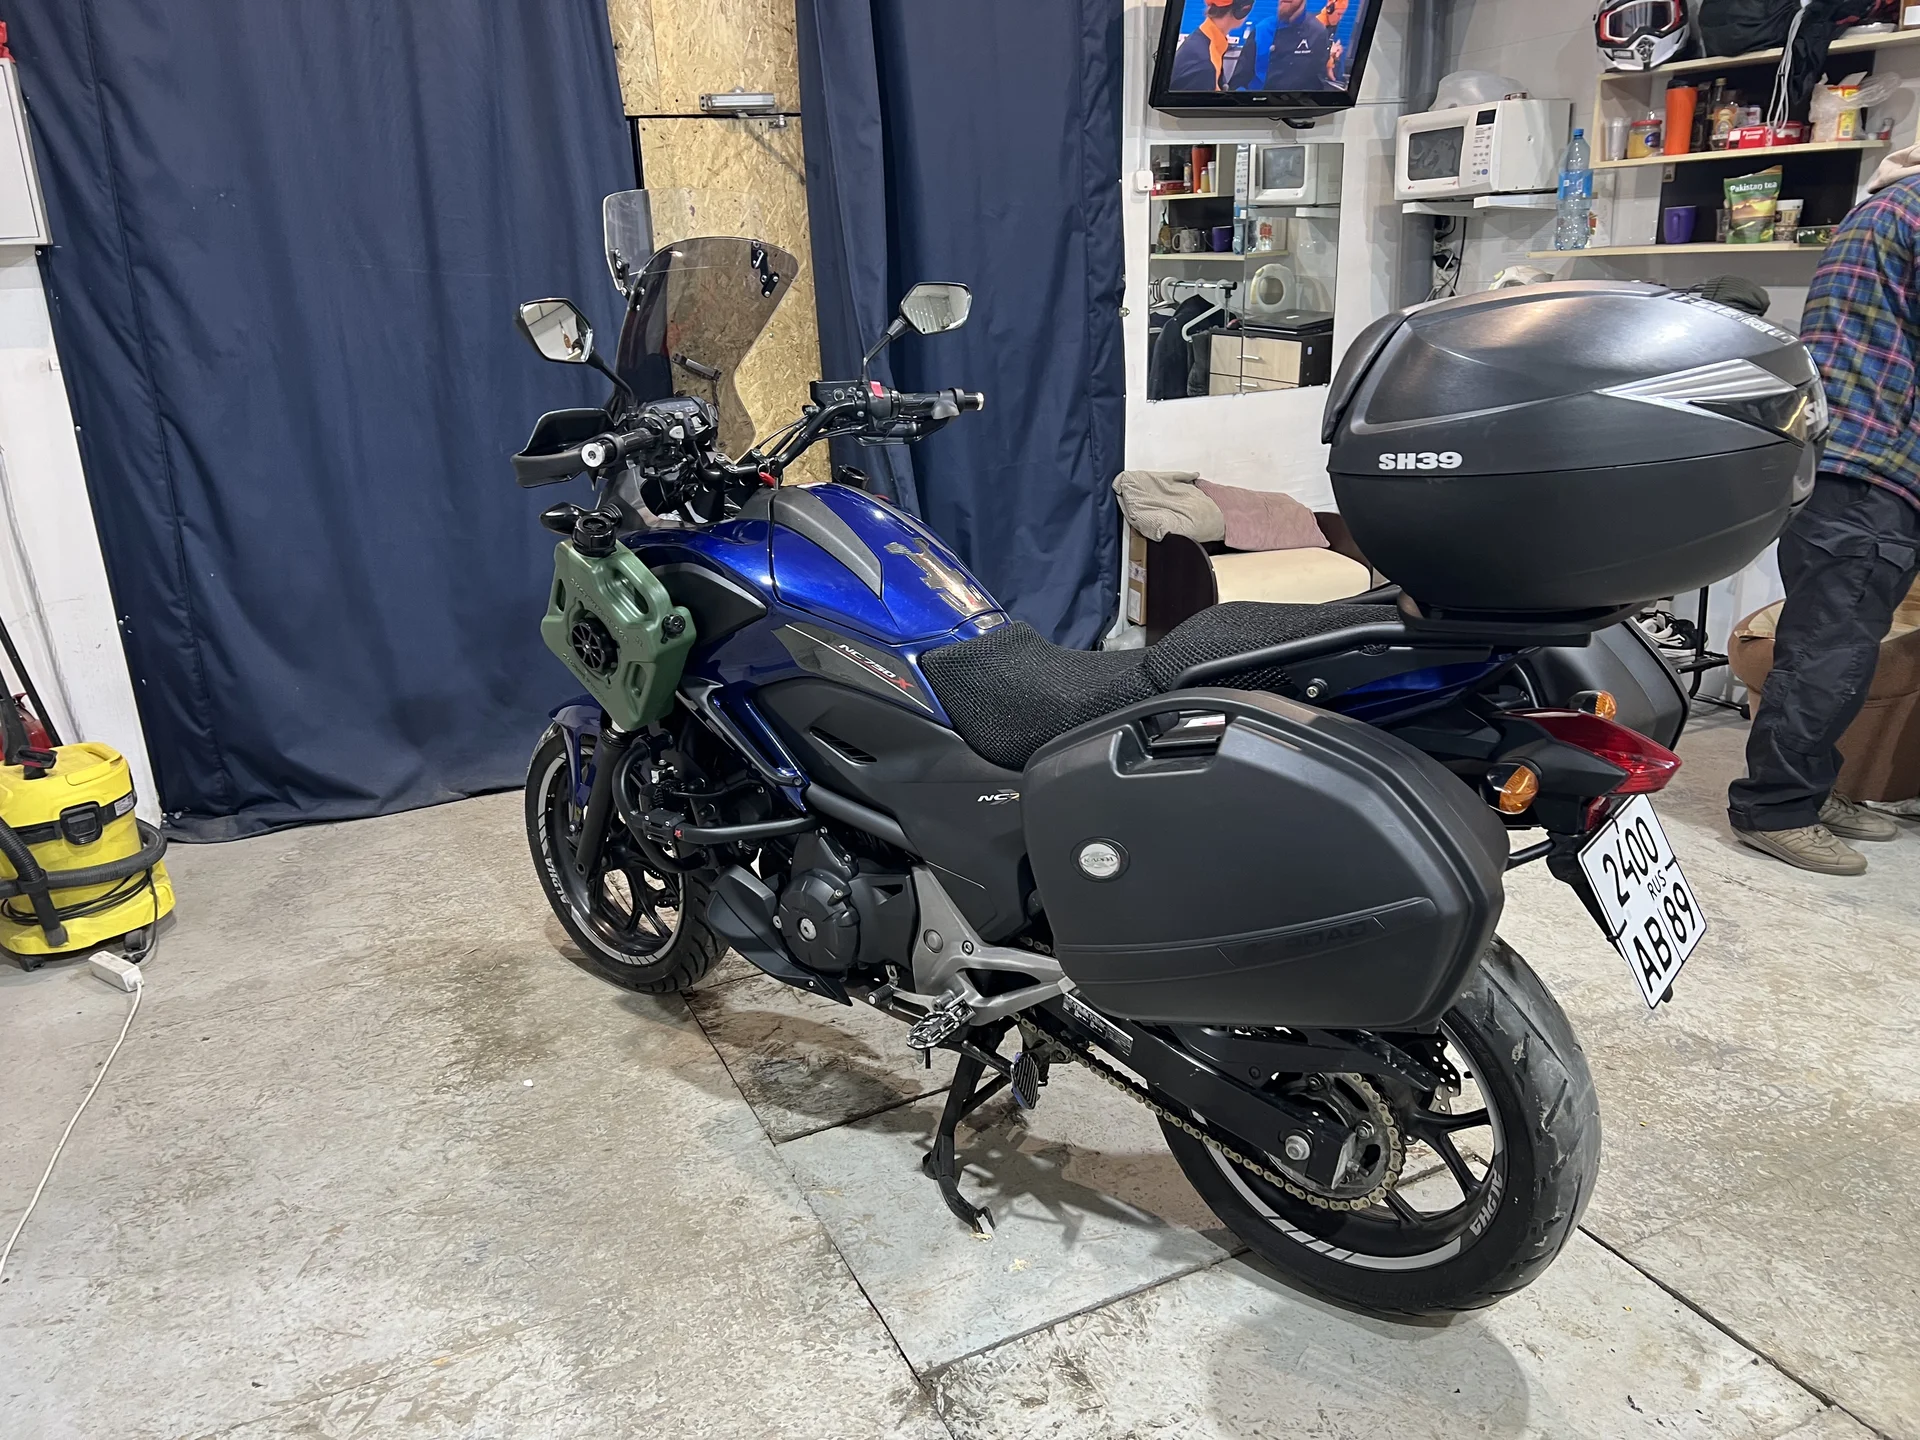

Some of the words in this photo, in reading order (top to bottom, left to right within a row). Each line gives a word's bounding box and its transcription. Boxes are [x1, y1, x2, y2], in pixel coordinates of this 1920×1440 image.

[1730, 183, 1763, 193] Pakistan
[1764, 181, 1778, 189] tea
[1378, 451, 1463, 470] SH39
[1602, 816, 1659, 908] 2400
[1647, 869, 1668, 901] RUS
[1633, 915, 1673, 994] AB
[1663, 881, 1696, 945] 89
[1469, 1167, 1503, 1236] ALPHA
